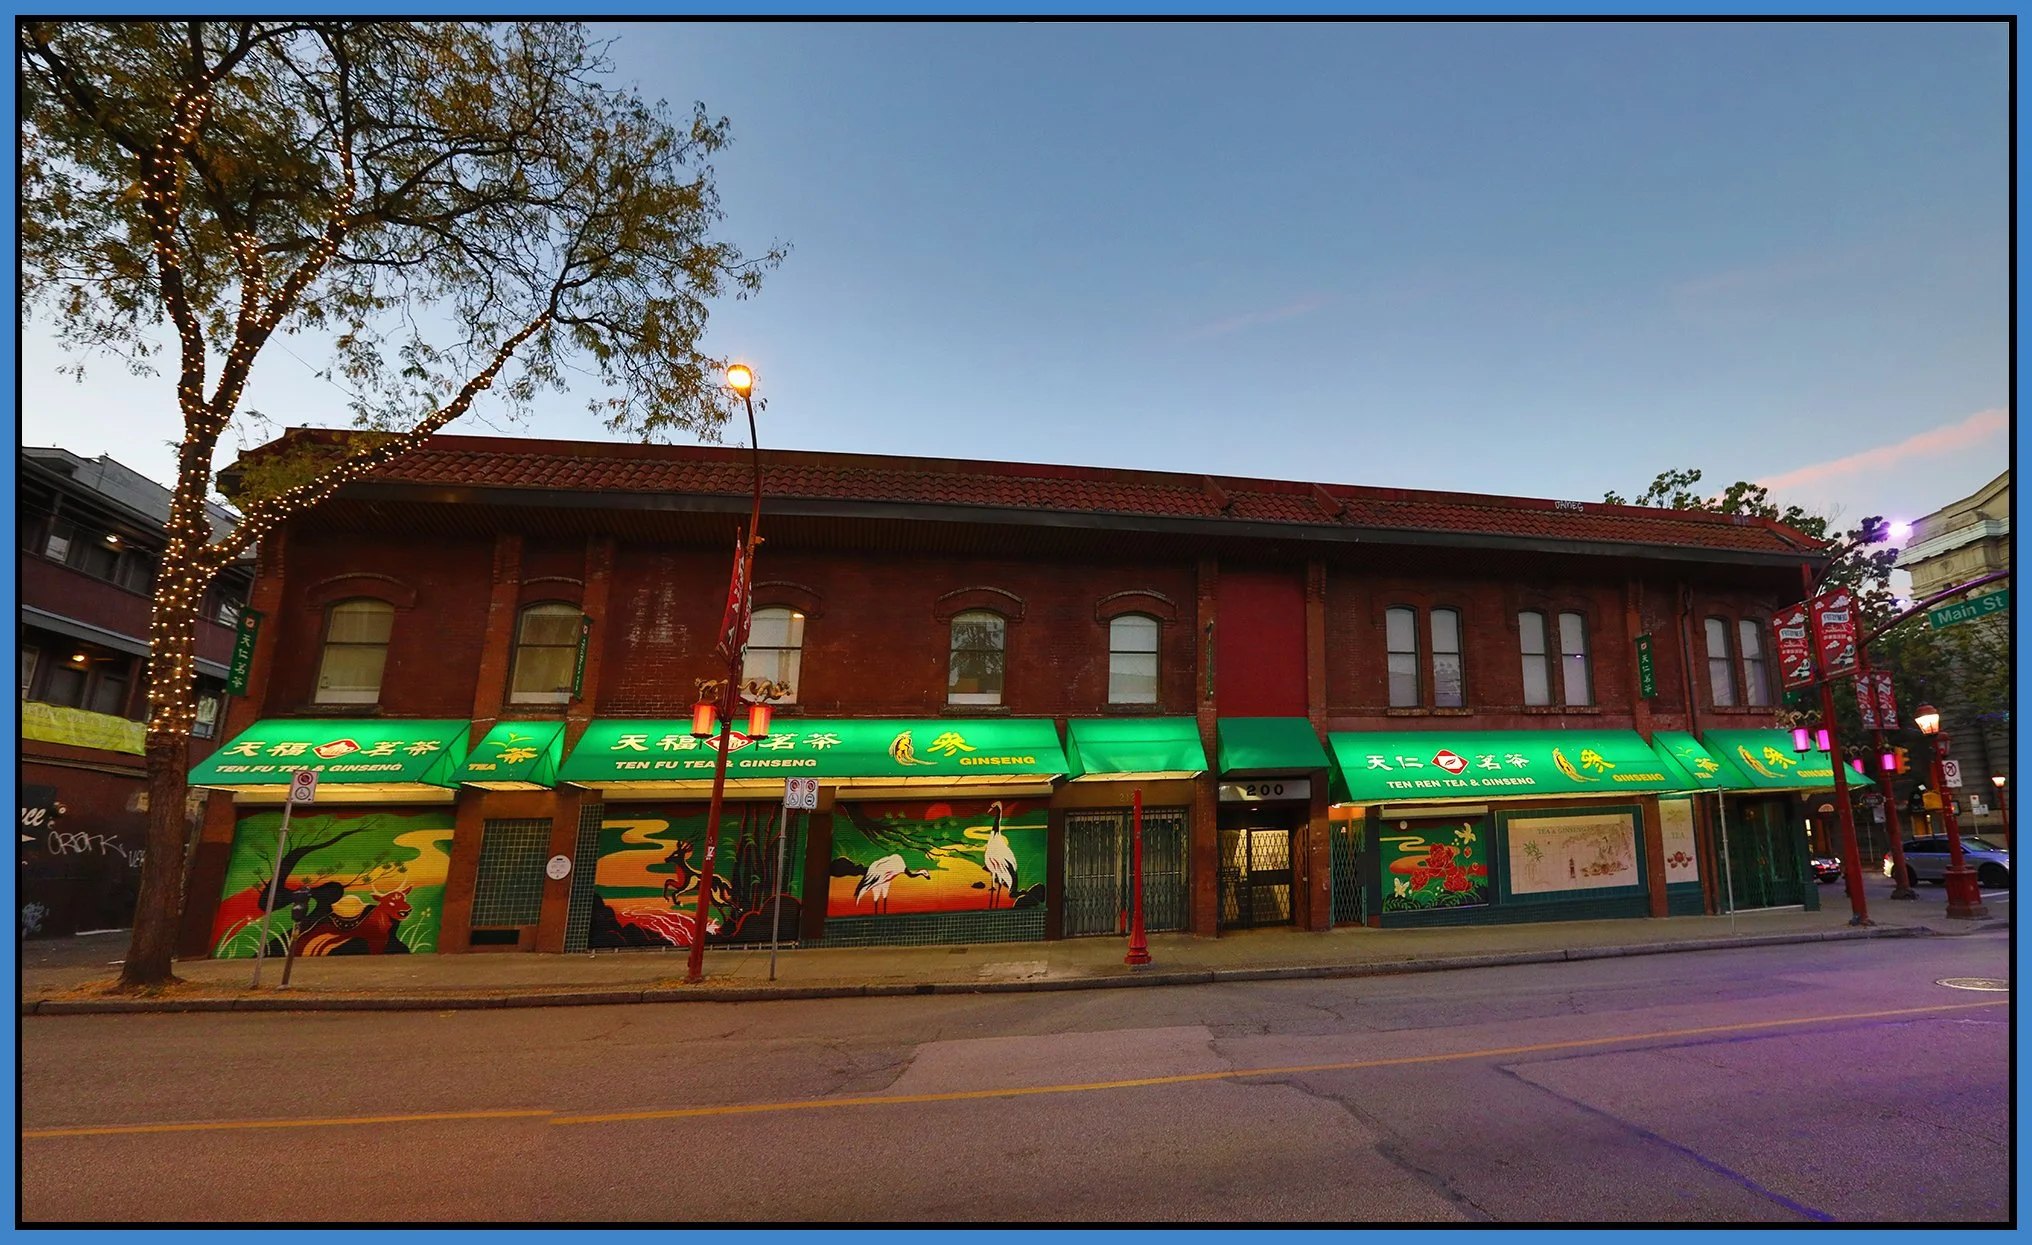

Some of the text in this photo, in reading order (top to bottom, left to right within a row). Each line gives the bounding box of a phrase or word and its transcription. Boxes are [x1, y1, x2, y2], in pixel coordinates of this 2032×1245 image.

[1937, 595, 2004, 625] Main St
[468, 762, 497, 771] TEA
[615, 760, 651, 769] TEN
[654, 760, 679, 769] FU
[683, 760, 716, 768] TEA
[739, 758, 817, 768] GINSENG
[959, 756, 1036, 766] GINSENG
[1365, 755, 1424, 771] 天仁
[215, 765, 251, 773] TEN
[249, 765, 276, 773] FU
[328, 762, 403, 772] GINSENG
[1386, 777, 1536, 789] TEN REN TEA & GINSENG
[1612, 773, 1665, 782] GINSENG
[1246, 784, 1285, 797] 200
